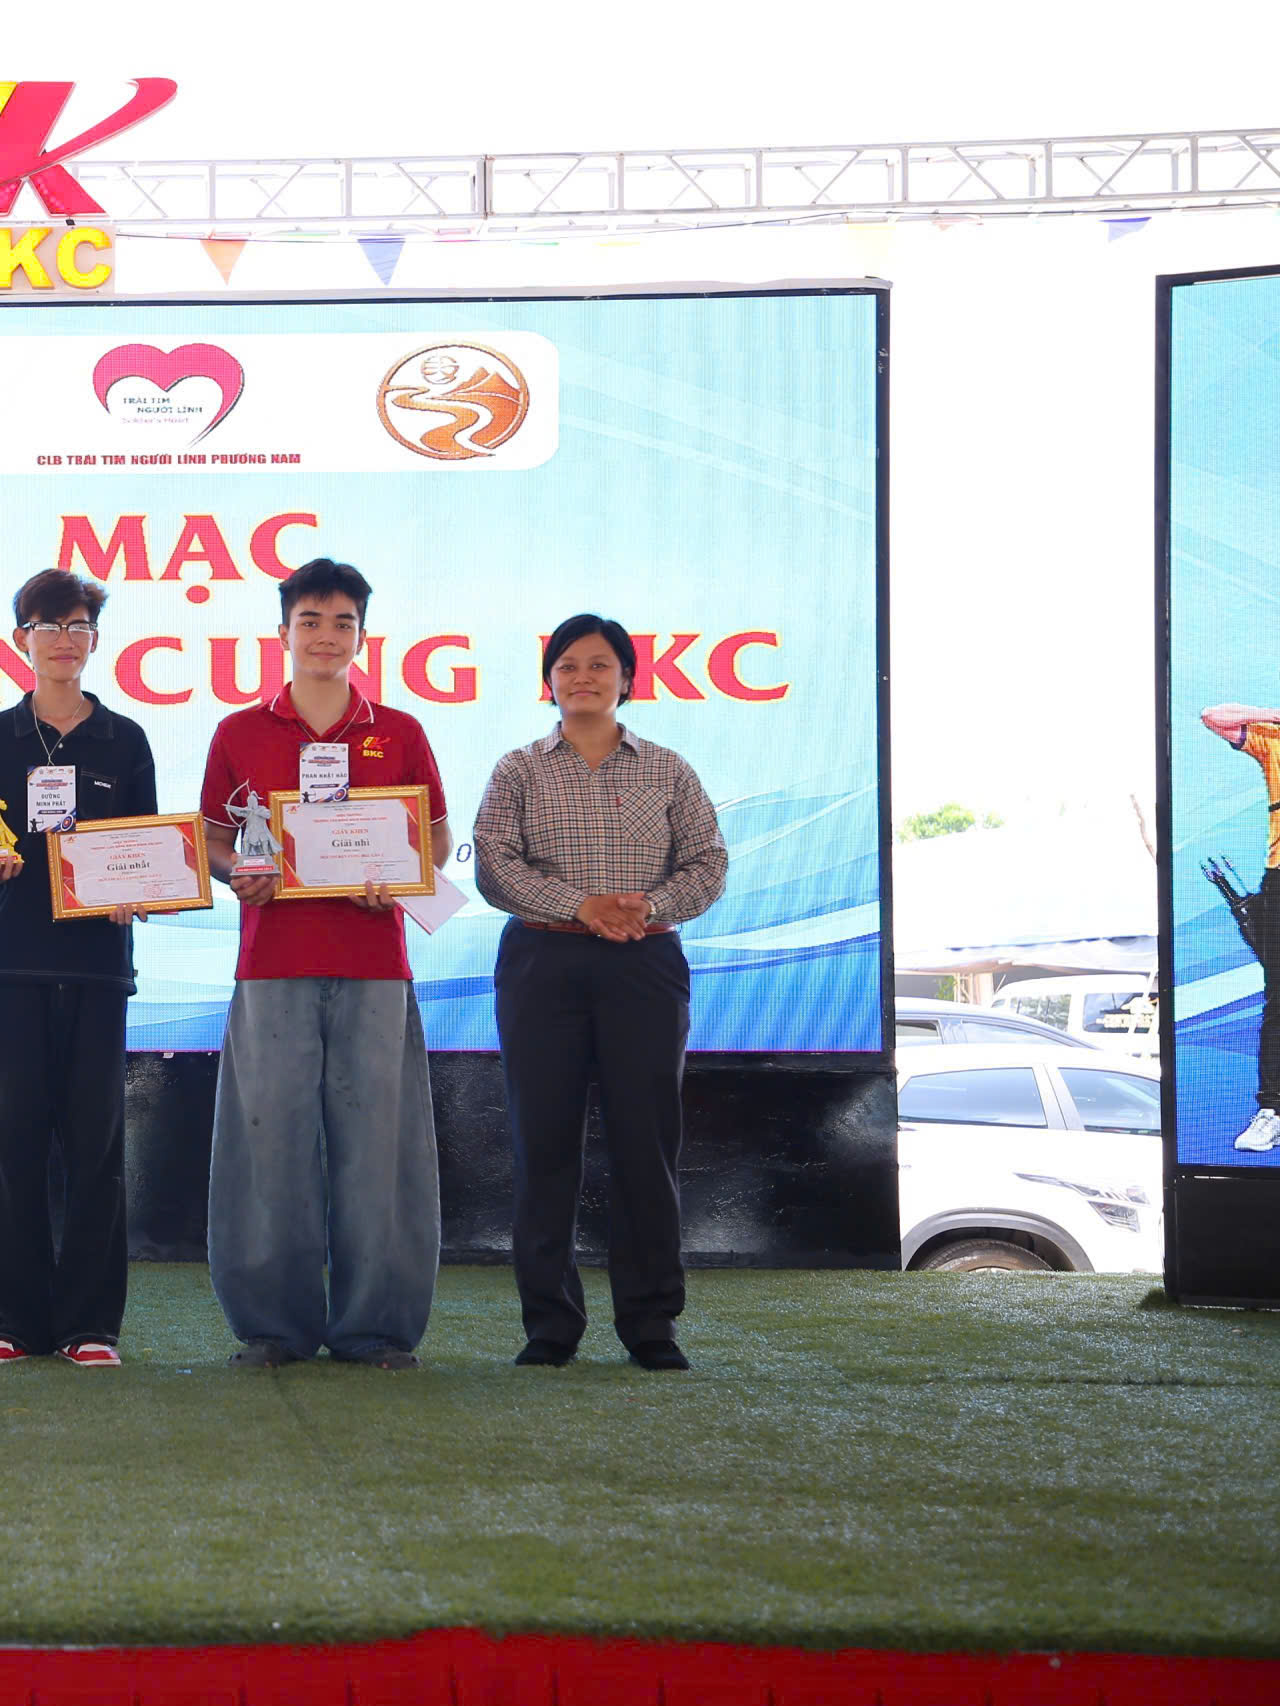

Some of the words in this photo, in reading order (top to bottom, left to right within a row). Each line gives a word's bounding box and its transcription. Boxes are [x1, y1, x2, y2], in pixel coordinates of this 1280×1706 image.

[37, 454, 63, 466] CLB
[101, 454, 126, 466] TIM
[270, 453, 302, 465] NAM
[57, 512, 318, 605] MẠC
[538, 631, 790, 702] KC
[362, 749, 385, 759] BKC
